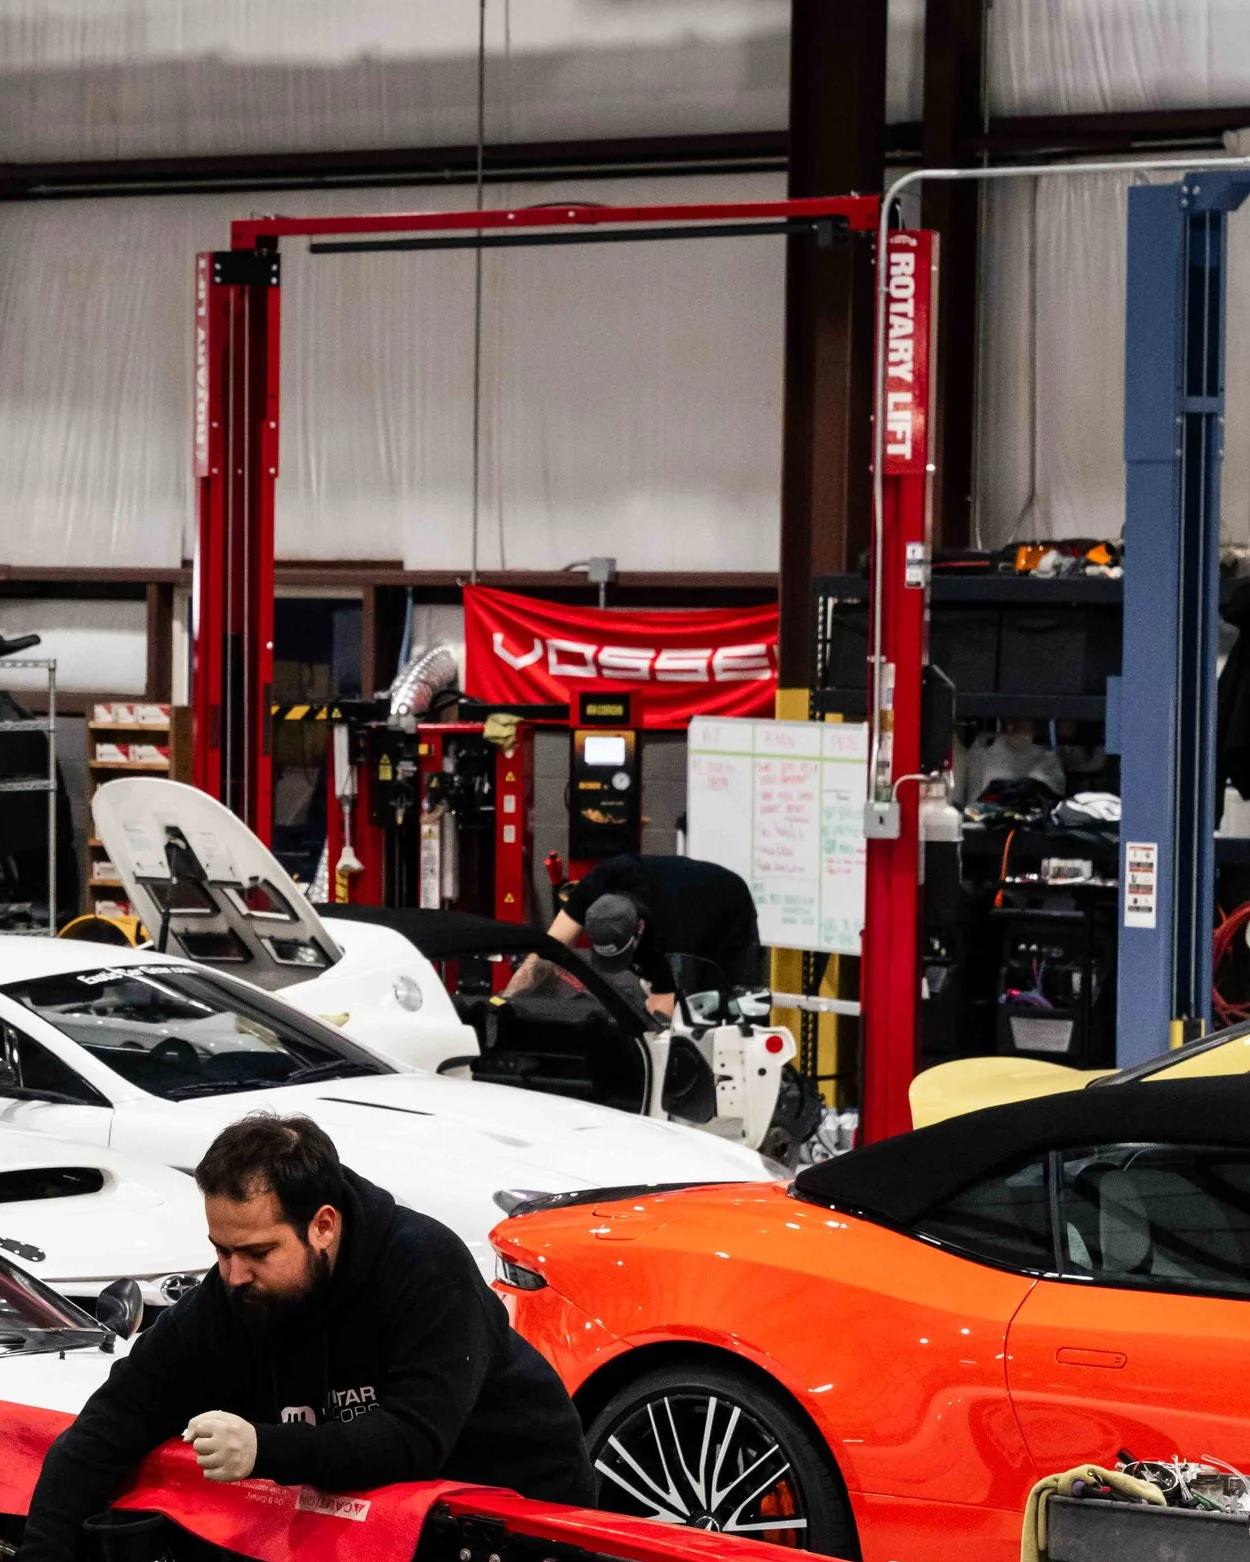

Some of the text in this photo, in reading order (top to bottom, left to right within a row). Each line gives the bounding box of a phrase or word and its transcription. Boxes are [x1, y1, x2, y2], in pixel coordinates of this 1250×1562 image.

[887, 252, 915, 460] ROTARY LIFT
[493, 632, 778, 682] VOSSE
